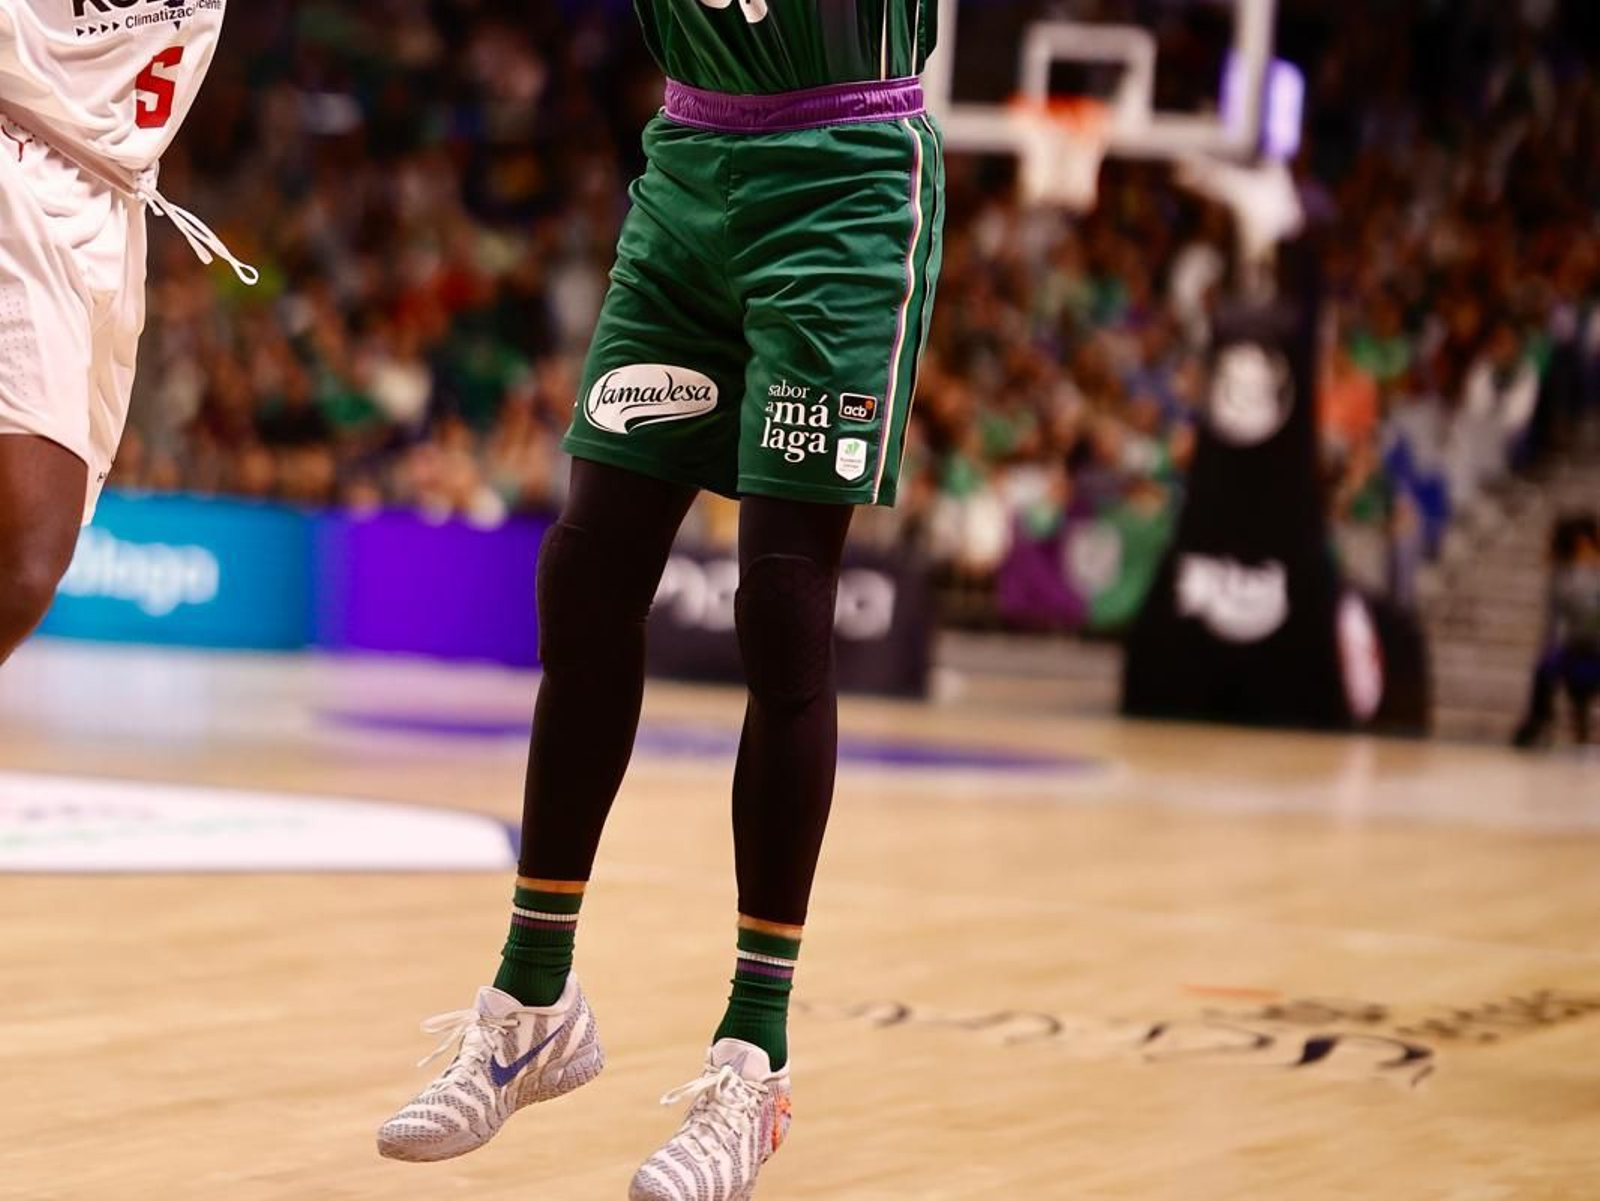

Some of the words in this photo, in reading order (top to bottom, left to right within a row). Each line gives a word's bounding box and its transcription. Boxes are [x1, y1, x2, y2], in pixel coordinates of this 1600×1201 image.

[125, 4, 196, 29] Climatizac
[590, 371, 711, 414] famadesa
[768, 379, 811, 399] sabor
[765, 401, 775, 413] a
[773, 394, 832, 429] má
[843, 405, 868, 419] acb
[760, 416, 829, 463] laga
